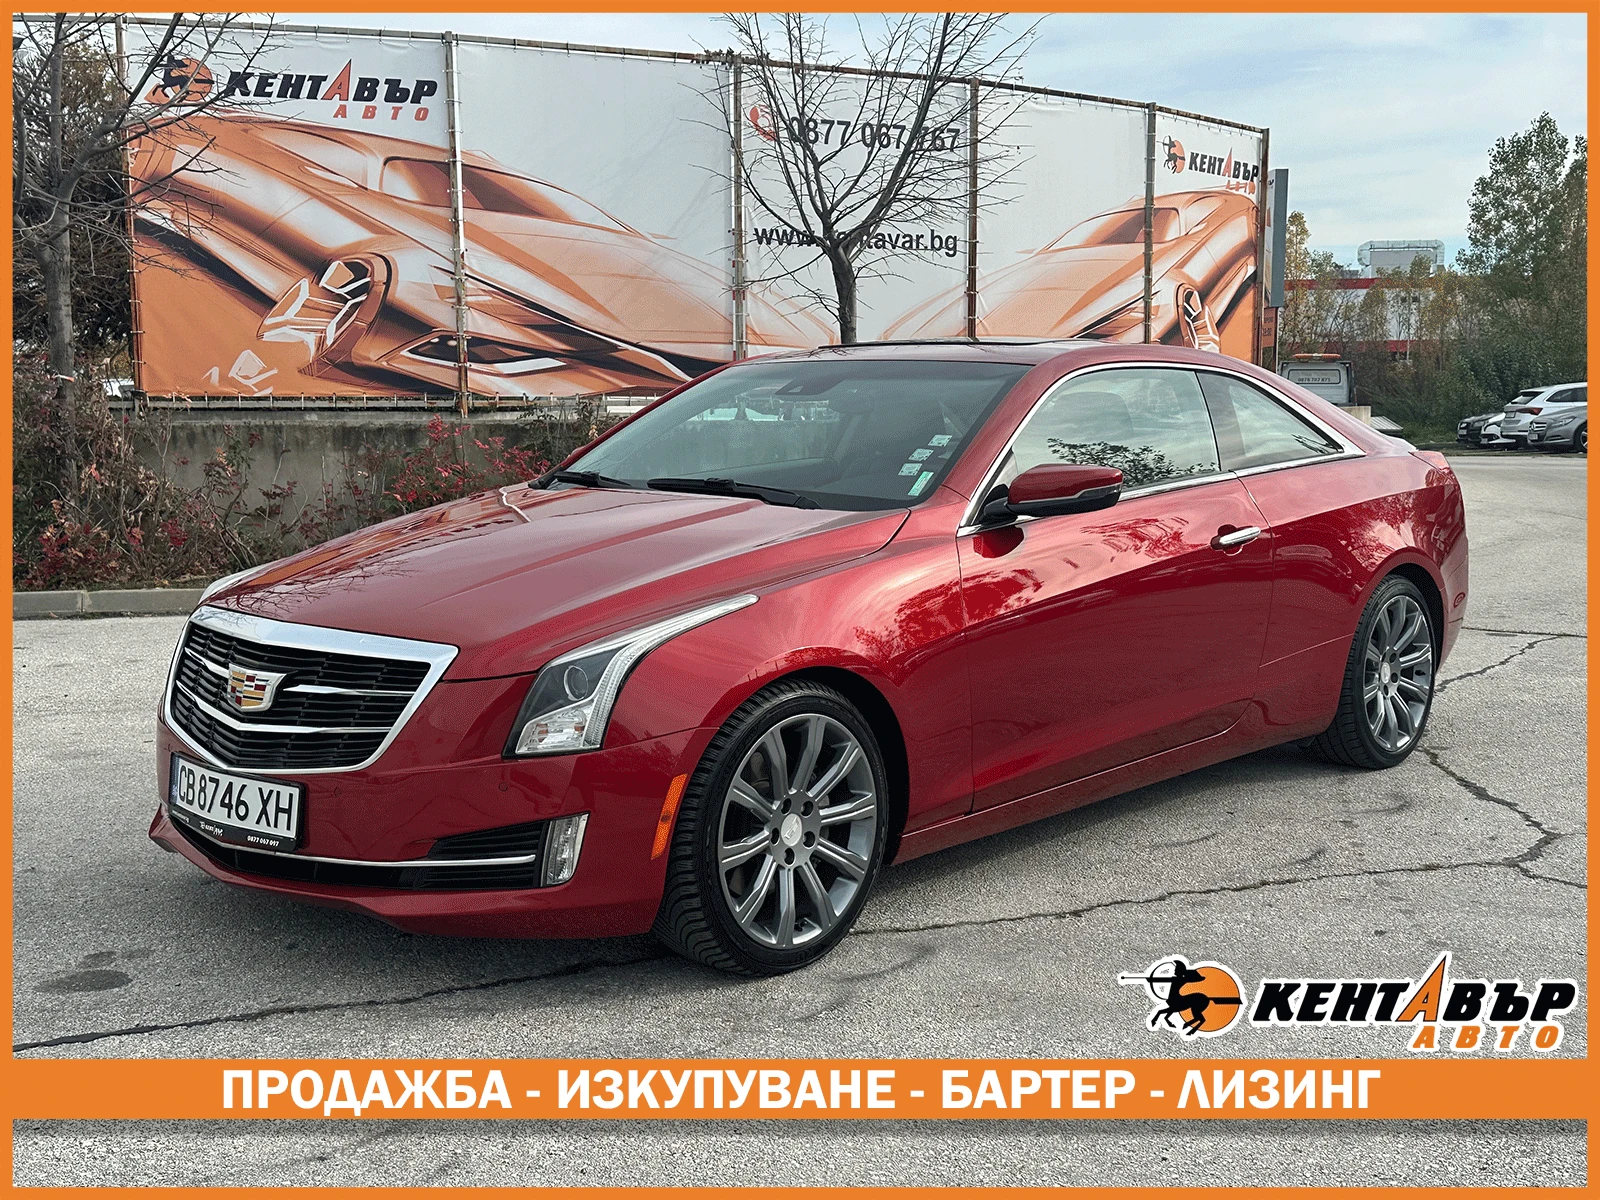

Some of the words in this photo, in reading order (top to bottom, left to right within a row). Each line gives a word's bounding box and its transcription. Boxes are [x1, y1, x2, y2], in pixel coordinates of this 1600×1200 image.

[223, 58, 438, 104] КЕНТАВЪР
[333, 104, 430, 121] АВТО
[861, 122, 907, 150] 067
[1188, 147, 1259, 182] КЕНТАВЪР
